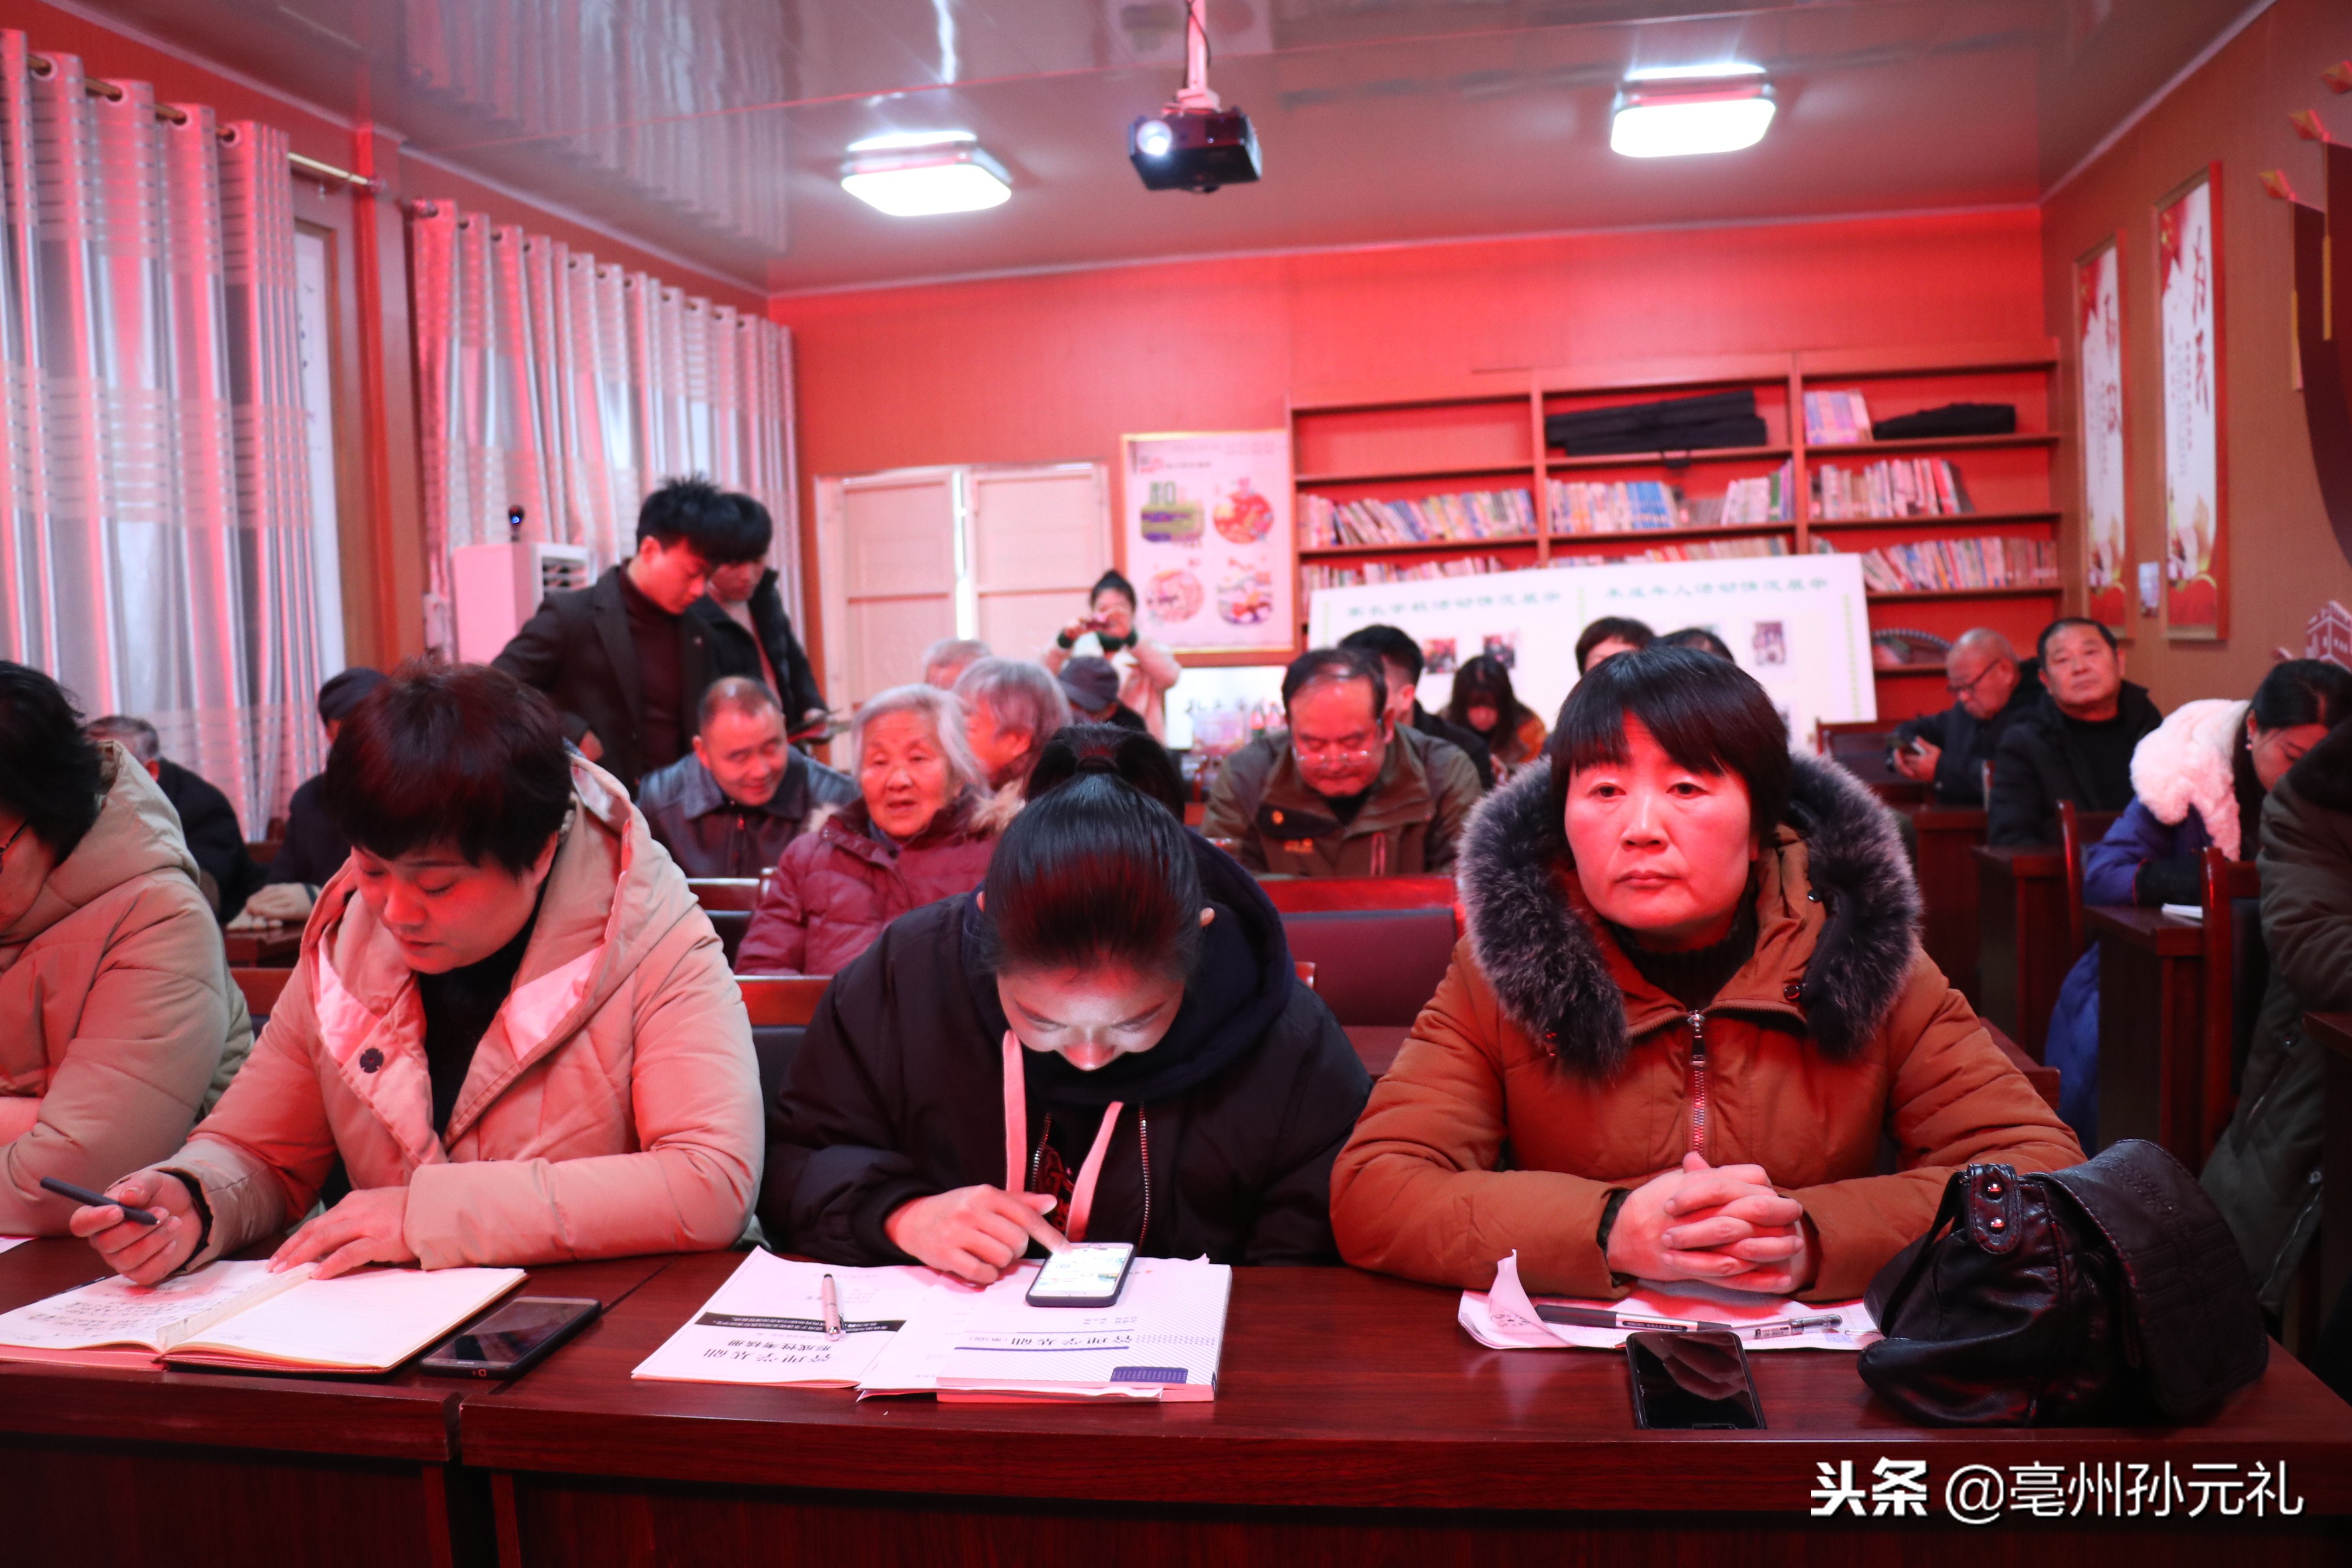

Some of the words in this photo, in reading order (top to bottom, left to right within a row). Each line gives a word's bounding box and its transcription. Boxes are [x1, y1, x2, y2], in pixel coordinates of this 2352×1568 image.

[727, 1339, 834, 1351] 形成性考核册
[703, 1348, 832, 1363] 管理学基础
